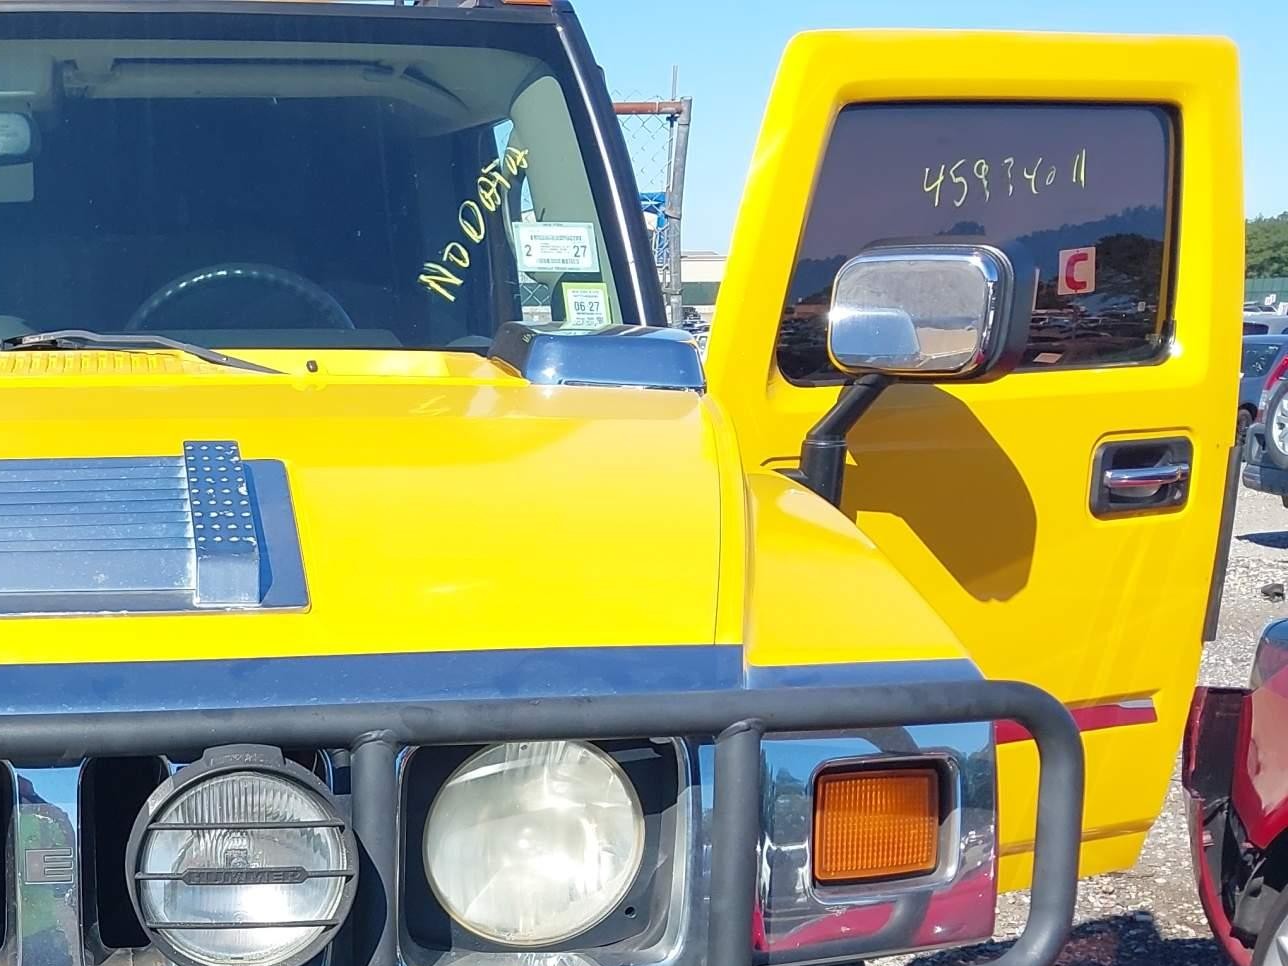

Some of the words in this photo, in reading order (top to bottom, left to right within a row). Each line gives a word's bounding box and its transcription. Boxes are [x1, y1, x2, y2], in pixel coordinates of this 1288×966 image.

[524, 244, 533, 257] 2
[572, 245, 587, 257] 27
[1065, 252, 1089, 292] C
